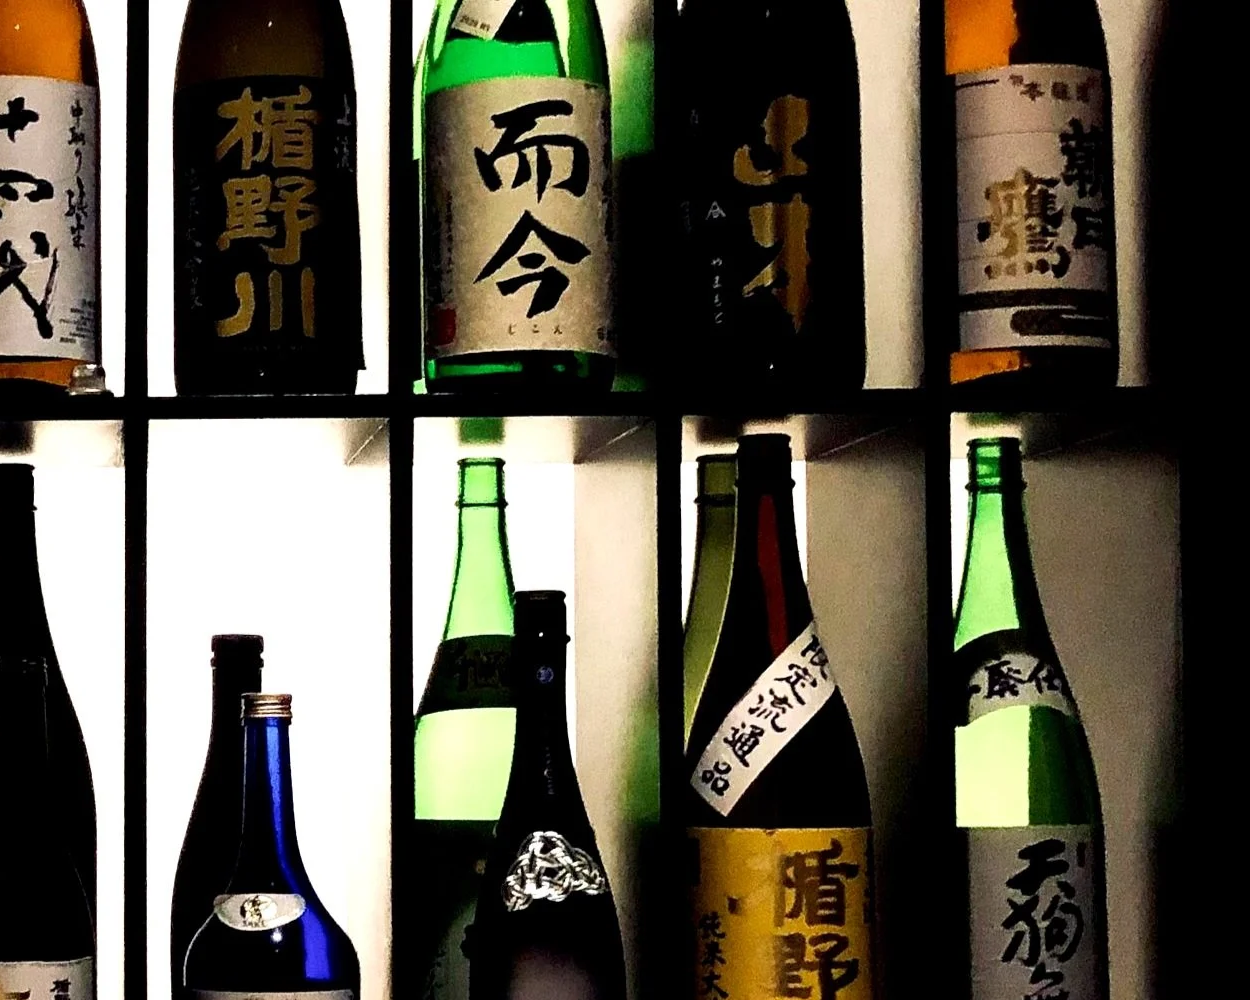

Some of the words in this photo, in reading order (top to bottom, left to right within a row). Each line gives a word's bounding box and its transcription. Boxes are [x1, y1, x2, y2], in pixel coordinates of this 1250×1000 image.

[214, 84, 327, 338] 楯野川
[473, 99, 591, 319] 而今
[702, 634, 829, 796] 限定流通品
